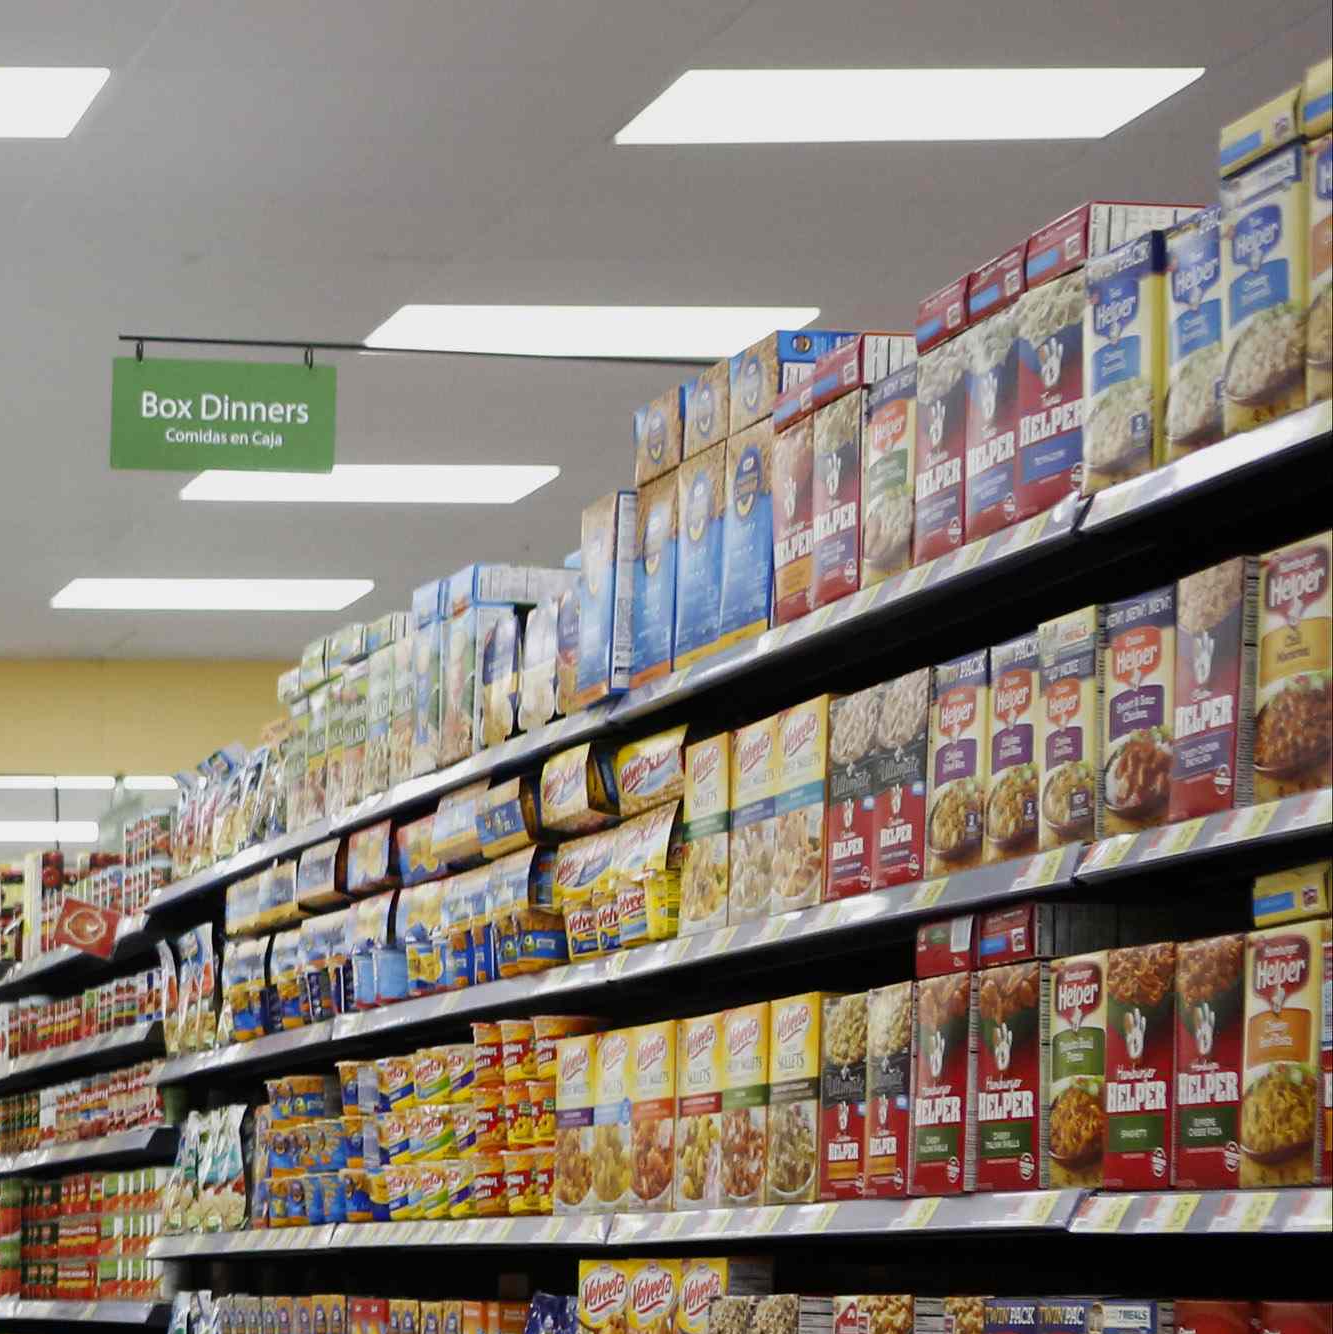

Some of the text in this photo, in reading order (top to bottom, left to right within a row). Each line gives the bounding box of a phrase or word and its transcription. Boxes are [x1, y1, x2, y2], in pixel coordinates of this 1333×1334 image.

[141, 390, 309, 425] Box Dinners
[165, 428, 283, 449] Comidas en Caja
[966, 430, 1016, 477] HELPER
[915, 457, 962, 498] HELPER
[813, 502, 857, 543] HELPER
[1269, 566, 1325, 608] Helper
[1116, 643, 1158, 673] Helper
[1174, 694, 1233, 740] HELPER
[1256, 958, 1306, 990] Helper
[1057, 981, 1099, 1010] Helper
[1106, 1080, 1167, 1112] HELPER
[1178, 1071, 1240, 1105] HELPER
[915, 1095, 961, 1127] HELPER
[978, 1090, 1033, 1122] HELPER
[584, 1273, 625, 1308] Velveeta
[633, 1273, 672, 1308] Velveeta
[683, 1273, 720, 1308] Velveeta
[985, 1306, 1035, 1325] TWIN PACK
[1039, 1306, 1083, 1325] TWIN PAC
